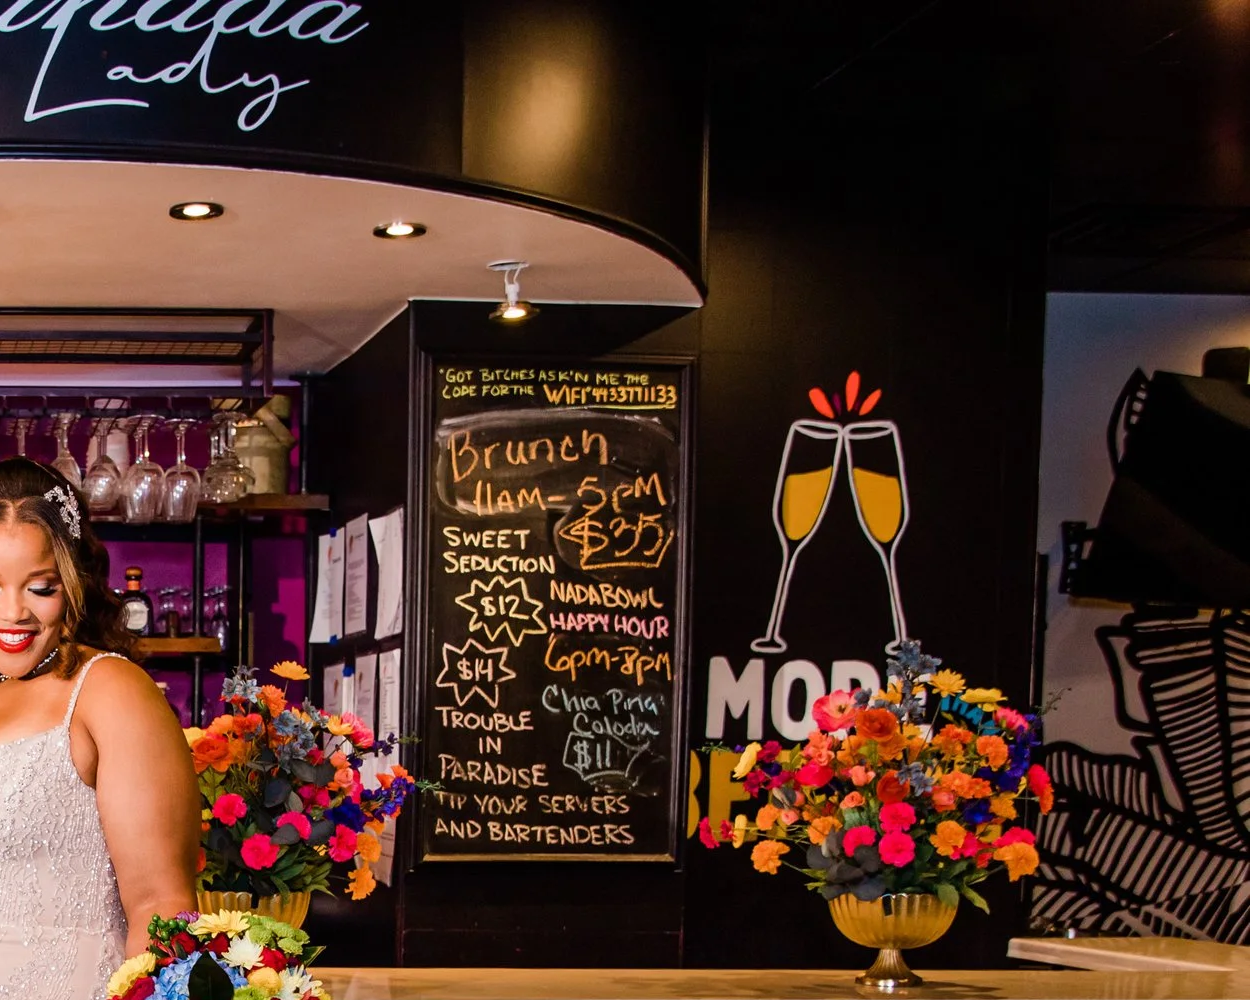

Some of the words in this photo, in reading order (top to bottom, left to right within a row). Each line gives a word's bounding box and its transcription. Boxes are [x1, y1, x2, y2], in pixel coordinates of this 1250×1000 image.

[23, 8, 310, 131] Lady
[479, 368, 535, 382] BITCHES
[595, 373, 620, 386] ME
[623, 373, 649, 386] THE
[442, 384, 477, 399] CODE
[447, 429, 608, 483] Brunch
[442, 526, 531, 550] SWEET
[570, 512, 665, 558] $35
[442, 551, 556, 574] SEDUCTION
[481, 595, 530, 619] $12
[550, 612, 609, 633] HAPPY
[614, 614, 669, 640] HOUR
[457, 657, 493, 682] $14
[542, 684, 601, 712] Chia
[435, 706, 534, 733] TROUBLE
[479, 735, 501, 755] IN
[573, 739, 610, 772] $11
[438, 753, 549, 789] PARADISE
[473, 793, 528, 815] YOUR
[538, 794, 630, 815] SERVERS
[435, 818, 482, 839] AND
[487, 821, 635, 845] BARTENDERS
